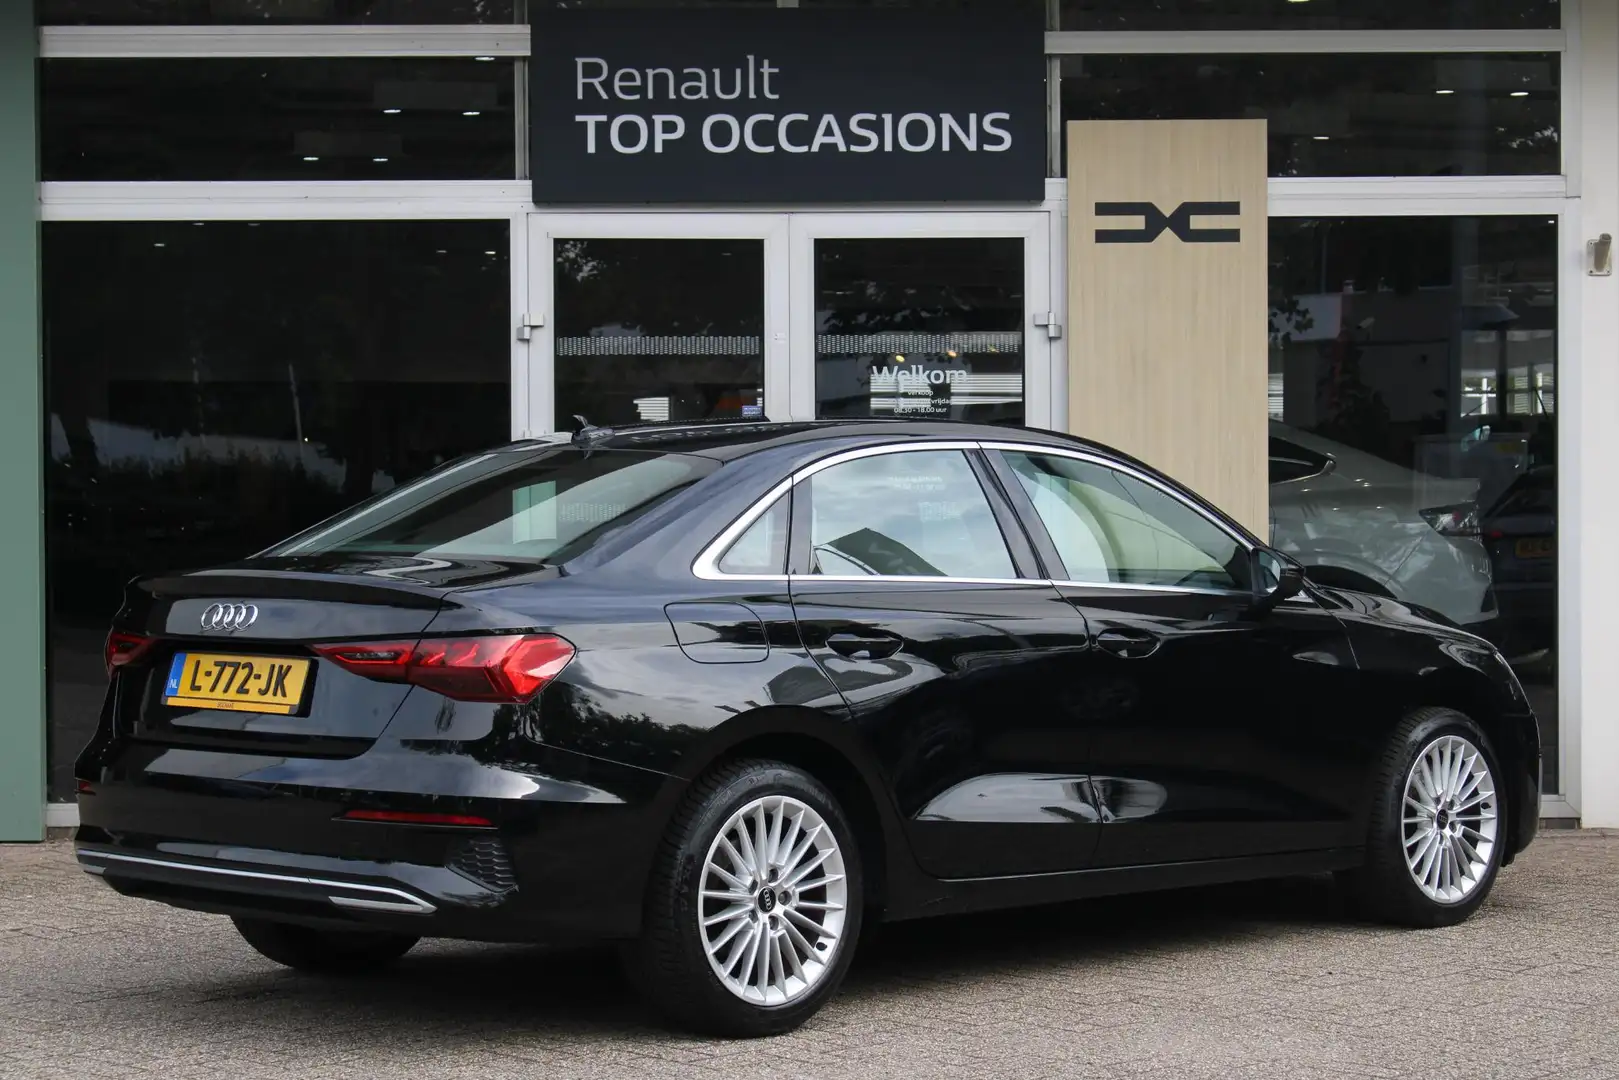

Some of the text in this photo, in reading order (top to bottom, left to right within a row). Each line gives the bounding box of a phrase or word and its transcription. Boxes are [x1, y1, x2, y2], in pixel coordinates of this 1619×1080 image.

[574, 55, 780, 101] Renault
[575, 111, 1013, 154] TOP OCCASIONS
[872, 364, 967, 384] Welkom
[168, 679, 178, 689] NL
[189, 659, 293, 698] L-772-JK
